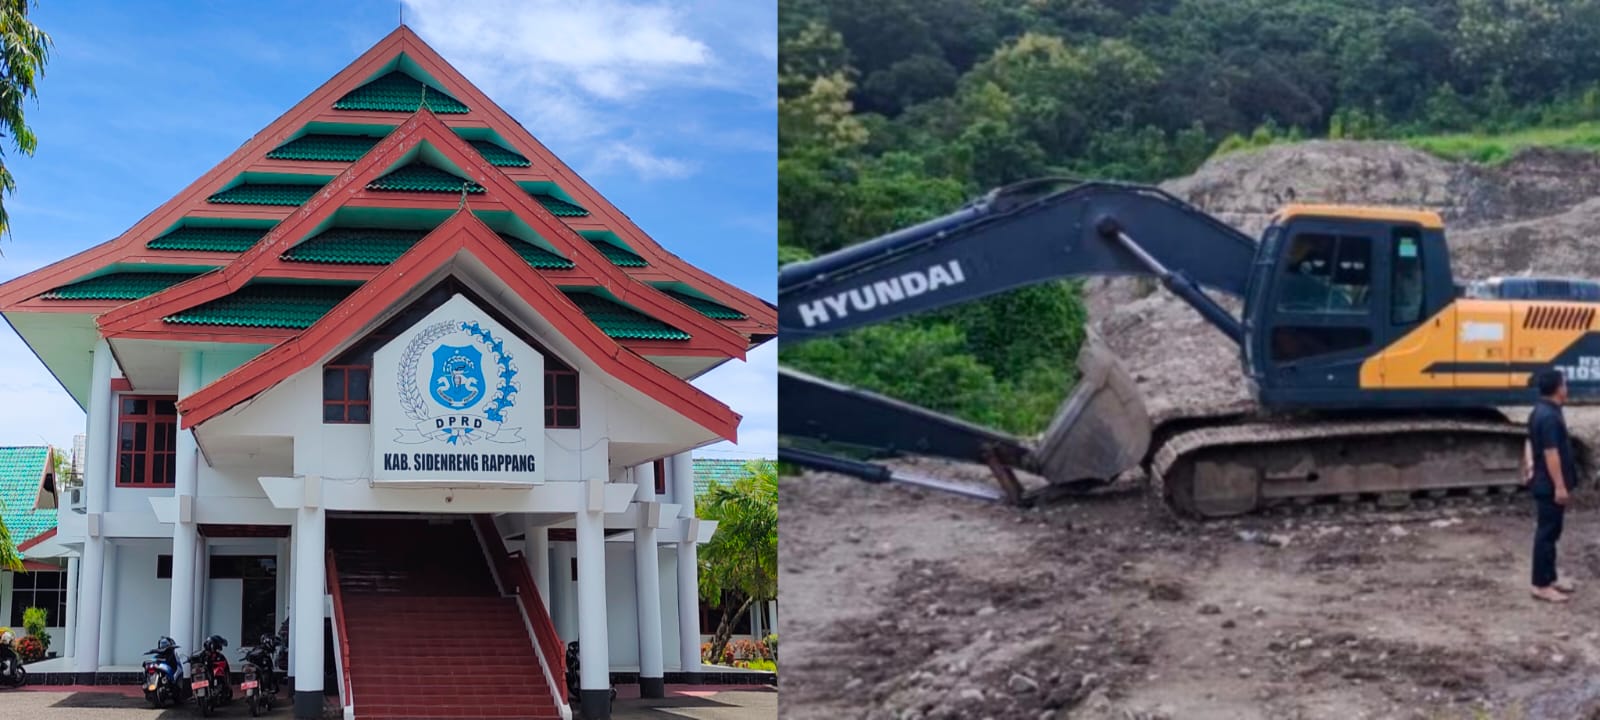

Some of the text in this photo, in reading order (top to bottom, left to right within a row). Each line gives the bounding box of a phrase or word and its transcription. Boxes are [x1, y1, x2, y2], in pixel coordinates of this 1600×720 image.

[797, 259, 966, 328] HYUNDAI
[435, 416, 482, 429] DPRD
[384, 453, 535, 472] KAB. SIDENRENG RAPPANG
